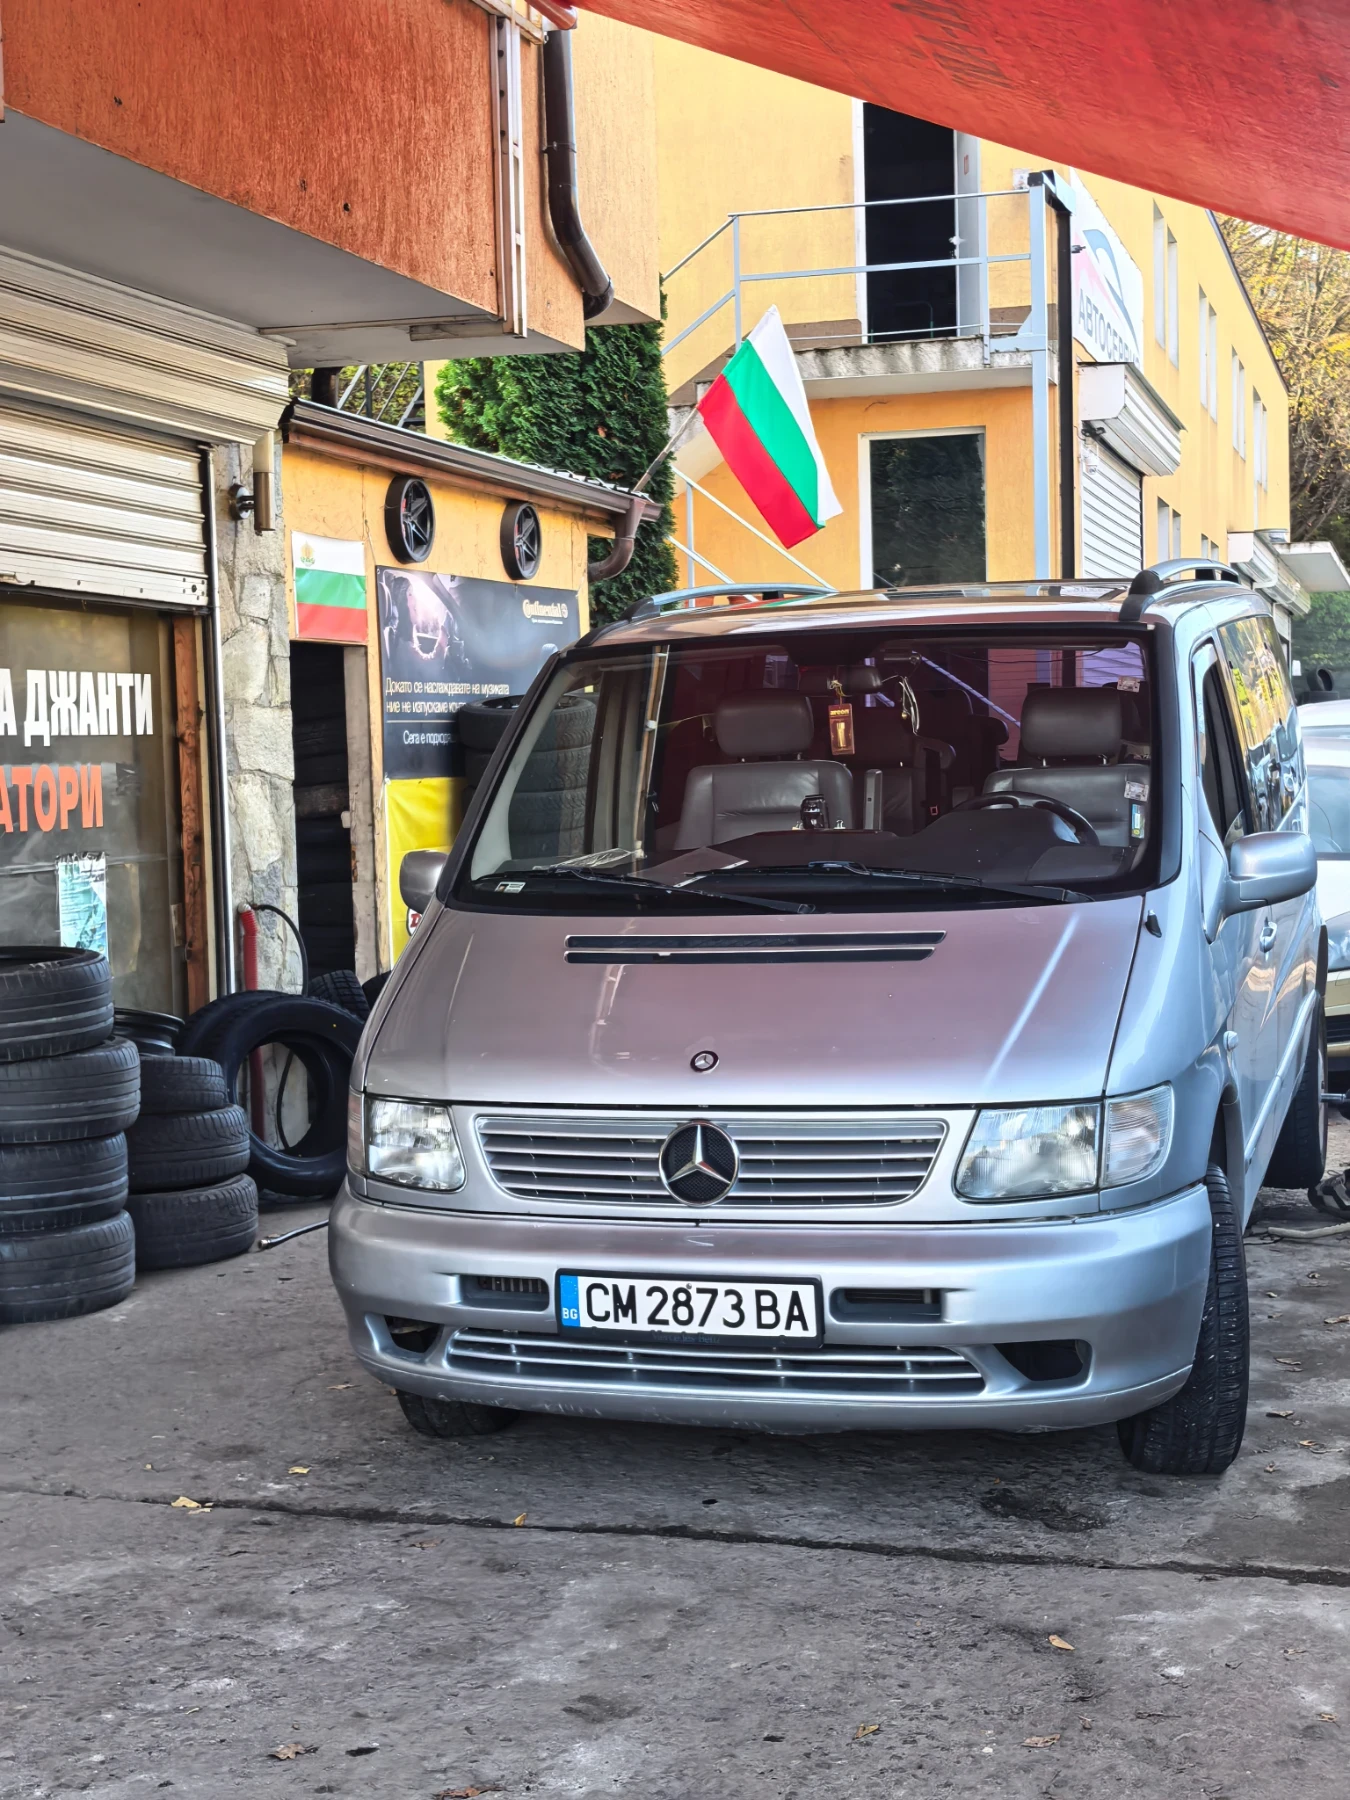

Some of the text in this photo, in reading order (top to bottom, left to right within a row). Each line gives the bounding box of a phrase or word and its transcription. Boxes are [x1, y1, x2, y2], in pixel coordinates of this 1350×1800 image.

[386, 677, 412, 695] Докато
[414, 681, 423, 693] се
[472, 683, 479, 694] на
[24, 669, 153, 746] ДЖАНТИ
[386, 701, 400, 712] ние
[402, 701, 411, 712] не
[403, 730, 420, 744] Сега
[562, 1307, 578, 1320] BG
[646, 1285, 745, 1328] 2873
